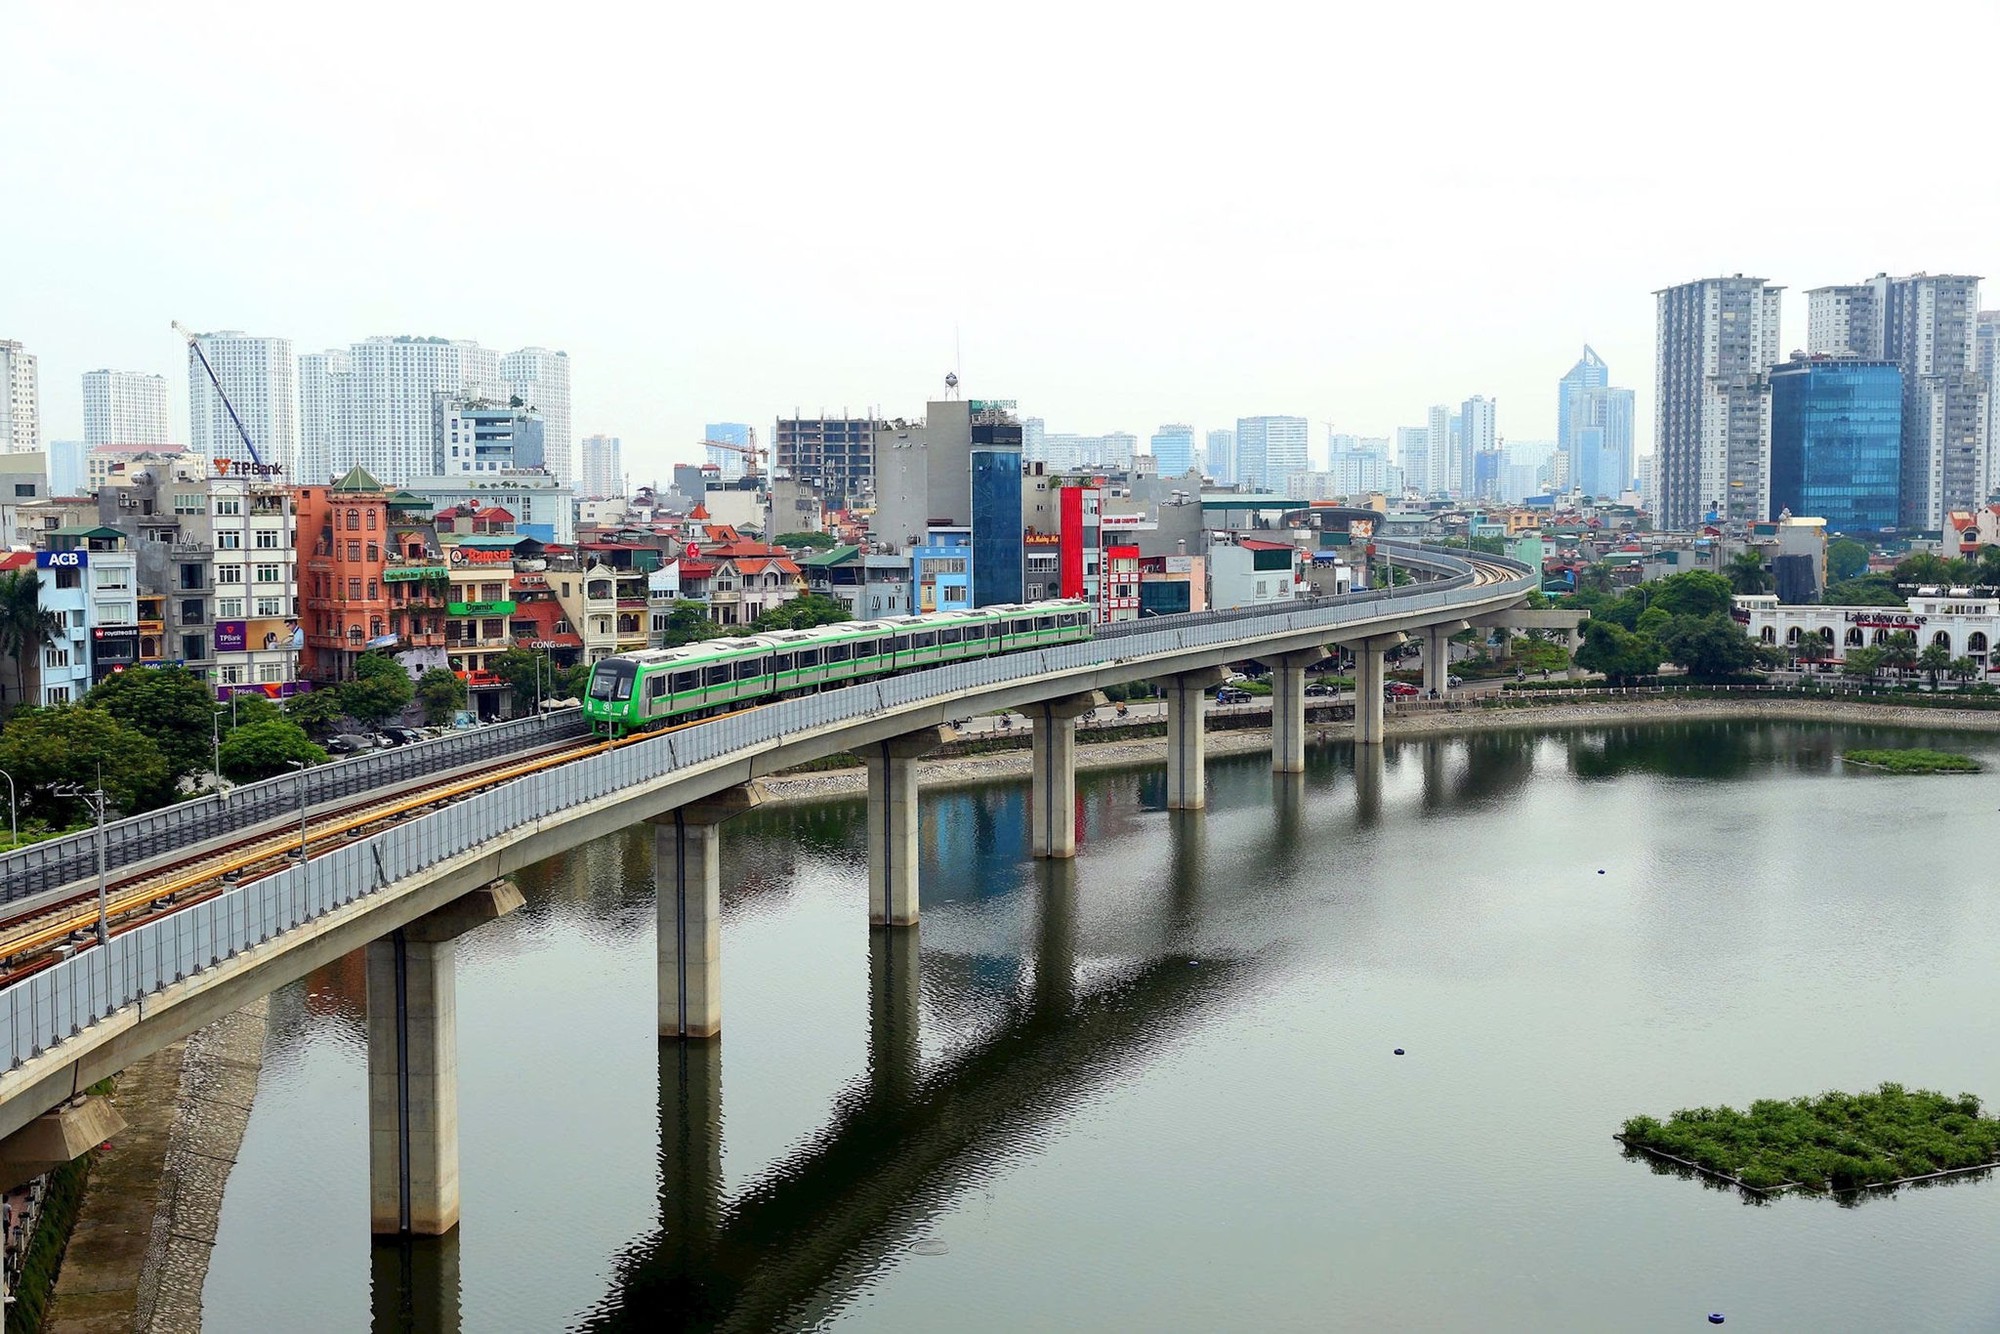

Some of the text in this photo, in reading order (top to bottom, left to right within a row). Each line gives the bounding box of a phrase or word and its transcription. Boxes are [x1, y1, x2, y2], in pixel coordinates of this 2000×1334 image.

[232, 461, 283, 476] TPBank
[48, 553, 79, 566] ACB
[1845, 611, 1870, 623] Lake
[1872, 612, 1894, 624] view
[220, 634, 242, 642] TPBank
